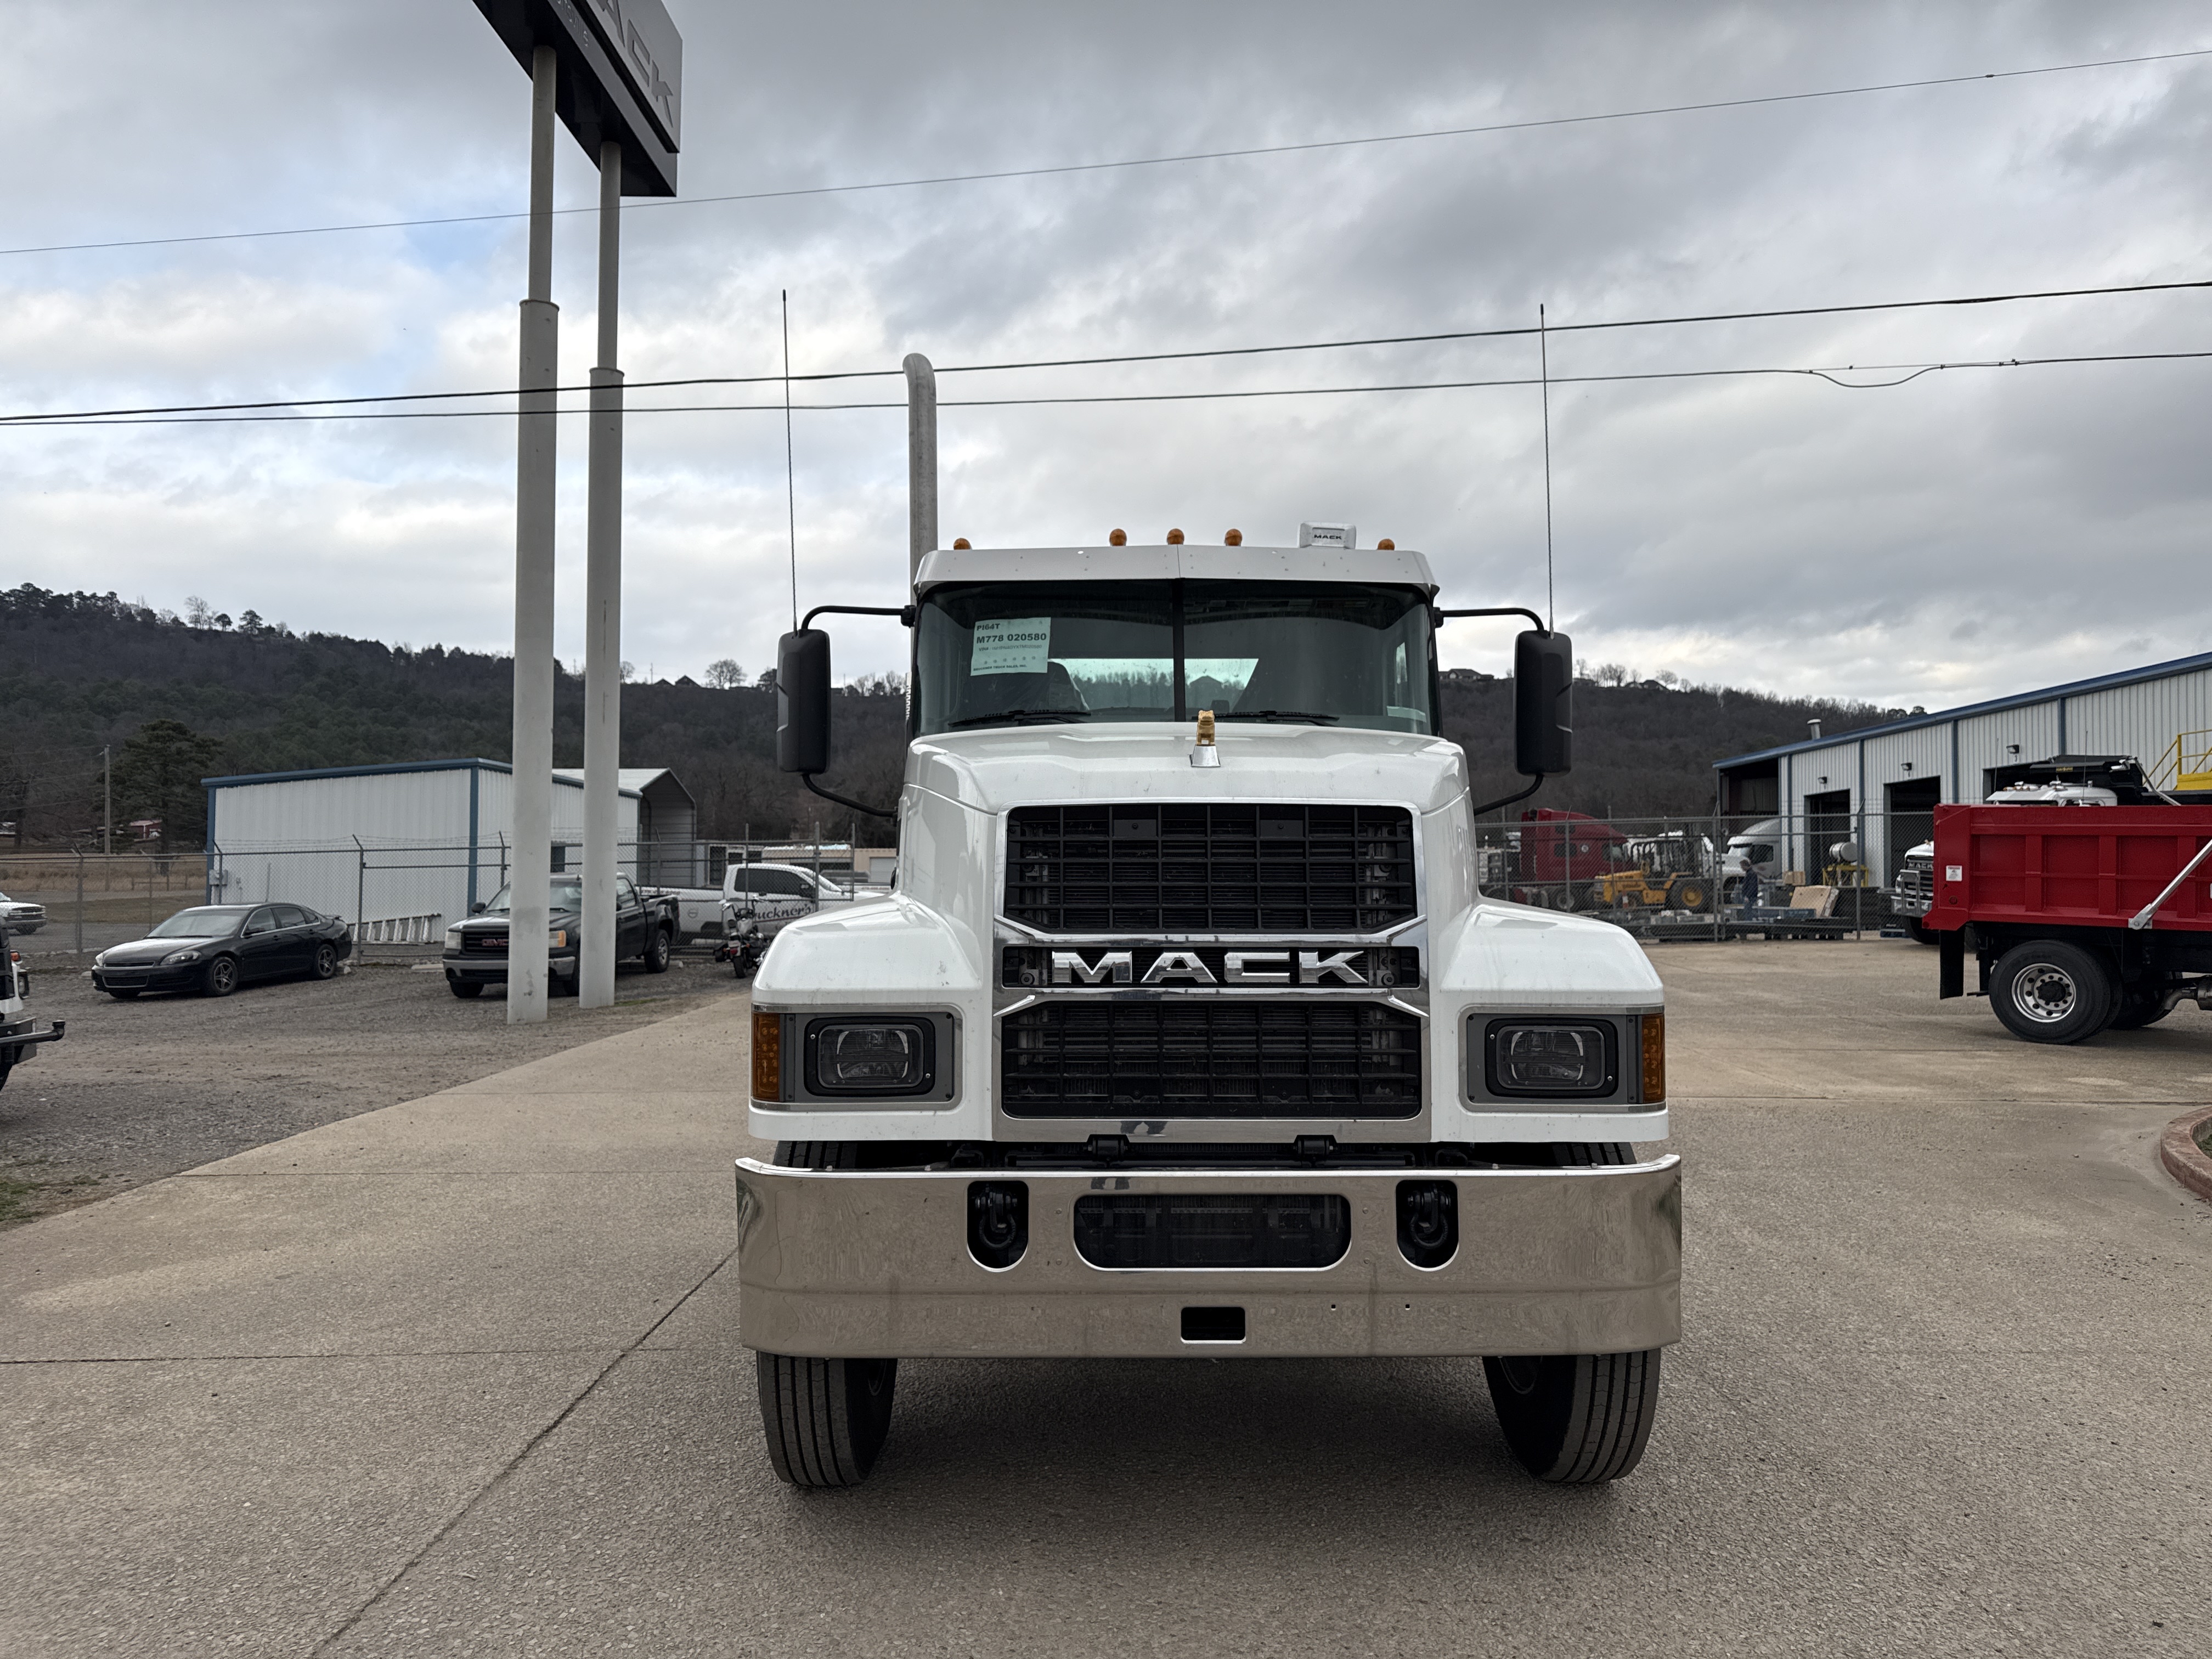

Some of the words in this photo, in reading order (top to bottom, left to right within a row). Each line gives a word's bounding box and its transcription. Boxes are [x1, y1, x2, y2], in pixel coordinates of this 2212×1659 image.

[977, 635, 1003, 644] M778
[1007, 633, 1047, 641] 020580
[757, 904, 812, 919] uckner's
[1052, 950, 1369, 984] MACK
